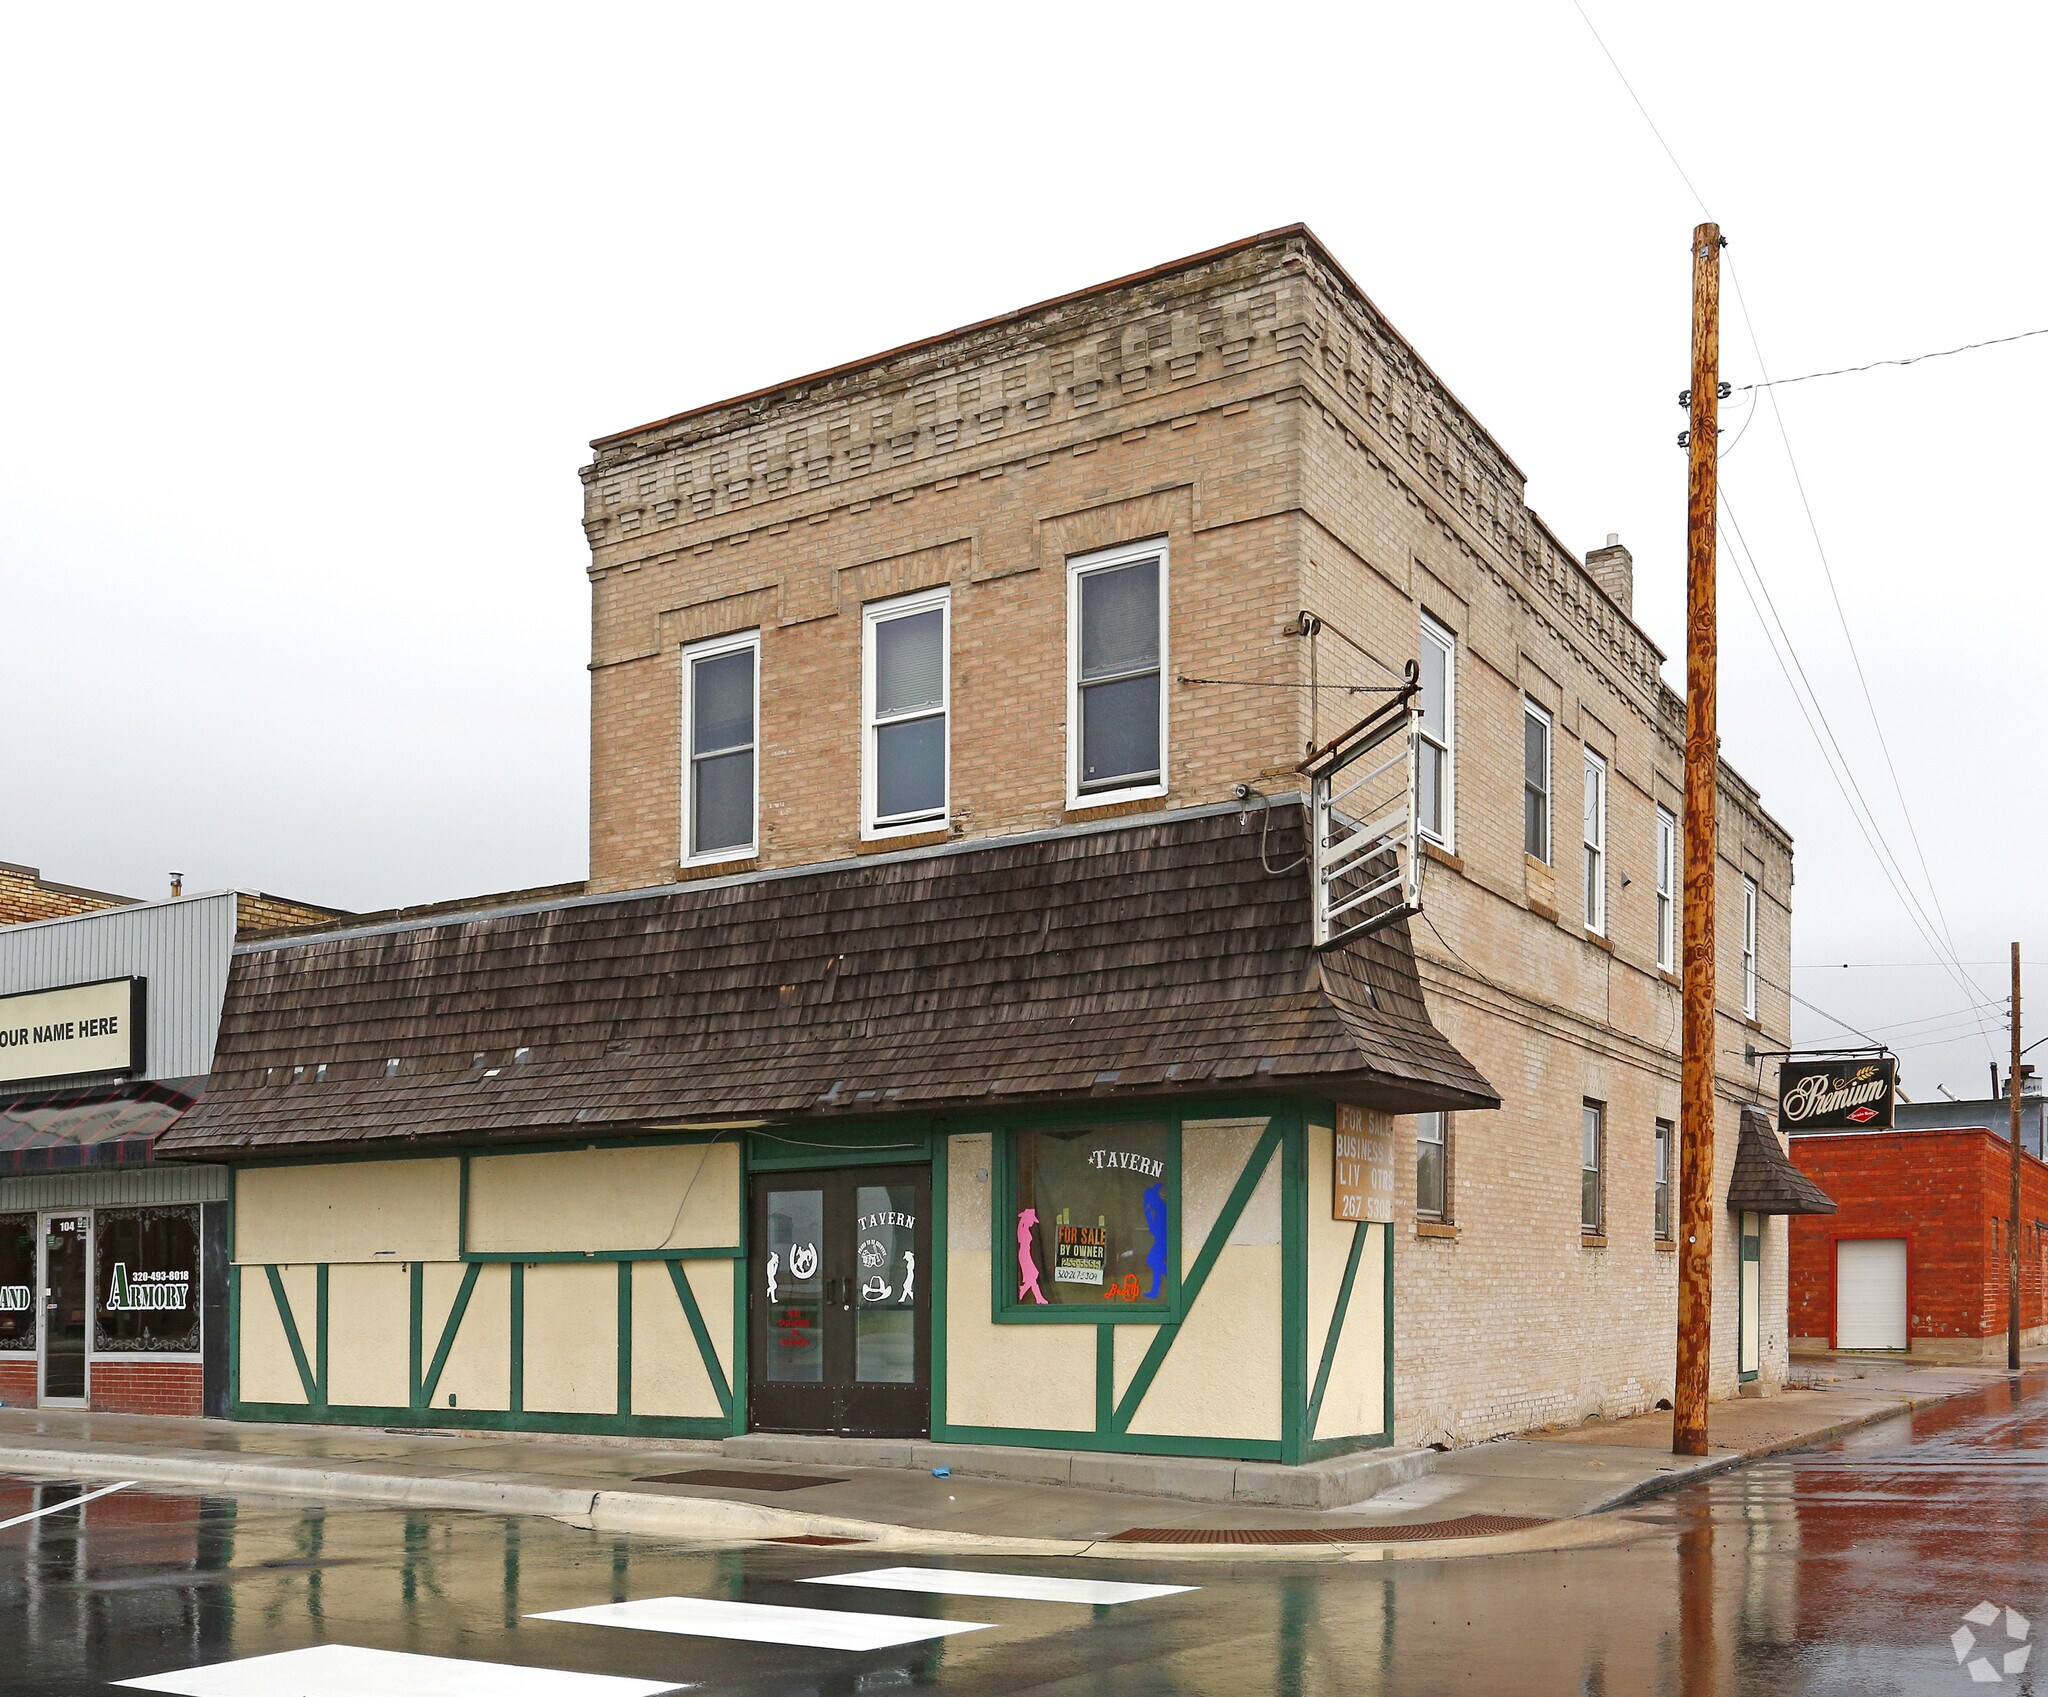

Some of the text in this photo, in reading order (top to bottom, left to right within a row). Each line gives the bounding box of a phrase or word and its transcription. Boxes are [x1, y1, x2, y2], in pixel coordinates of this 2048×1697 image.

[0, 1016, 118, 1048] OUR NAME HERE
[1783, 1074, 1888, 1121] Premium
[1342, 1106, 1362, 1132] FOR
[1336, 1134, 1384, 1163] BUSINESS
[1092, 1149, 1165, 1178] TAVERN
[1340, 1162, 1361, 1187] LIV
[1342, 1195, 1392, 1219] 267 5309
[59, 1221, 75, 1232] 104
[857, 1211, 916, 1231] TAVERN
[1058, 1226, 1106, 1246] FOR SALE
[1060, 1244, 1104, 1258] BY OWNER
[106, 1262, 189, 1311] ARMORY
[132, 1271, 189, 1282] 320-493-8018
